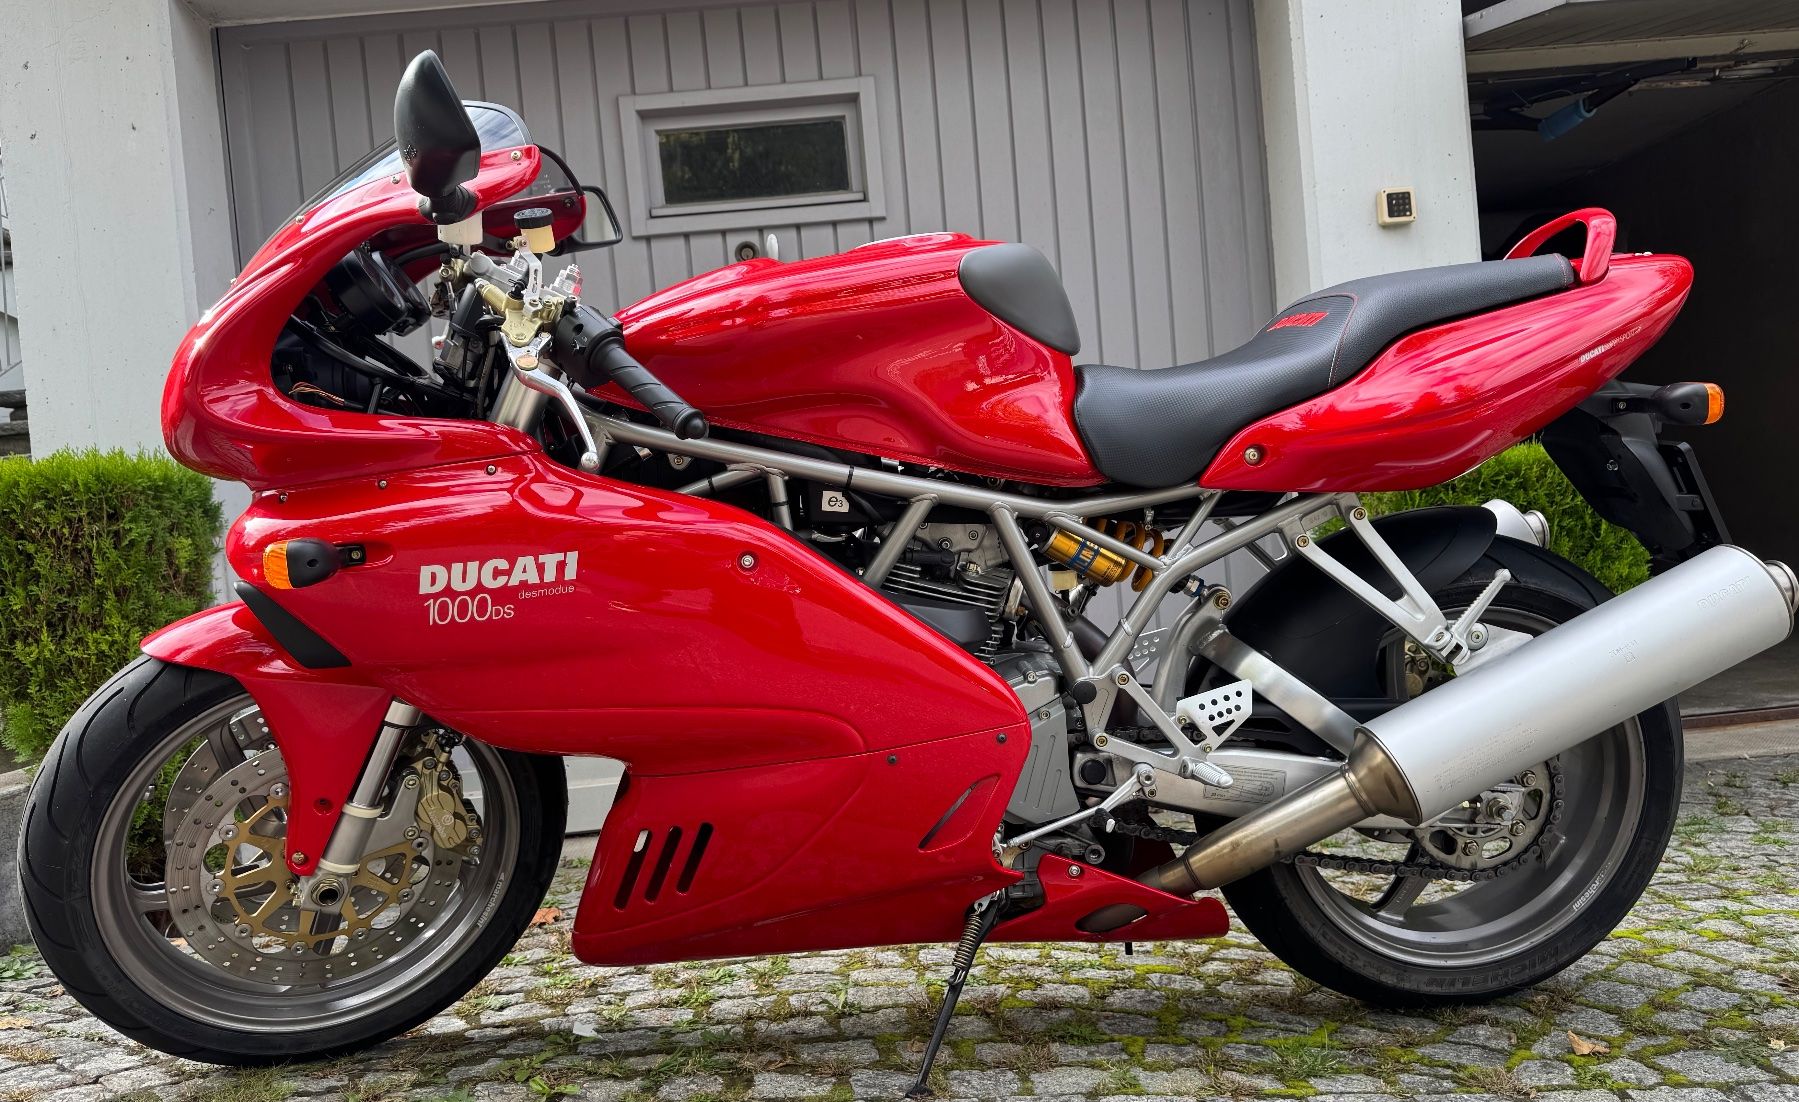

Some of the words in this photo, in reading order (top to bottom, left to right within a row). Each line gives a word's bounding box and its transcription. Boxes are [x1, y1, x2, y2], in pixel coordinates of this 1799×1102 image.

[1580, 344, 1605, 363] DUCATI
[418, 550, 579, 595] DUCATI
[518, 585, 575, 600] desmodue
[424, 593, 515, 626] 1000DS
